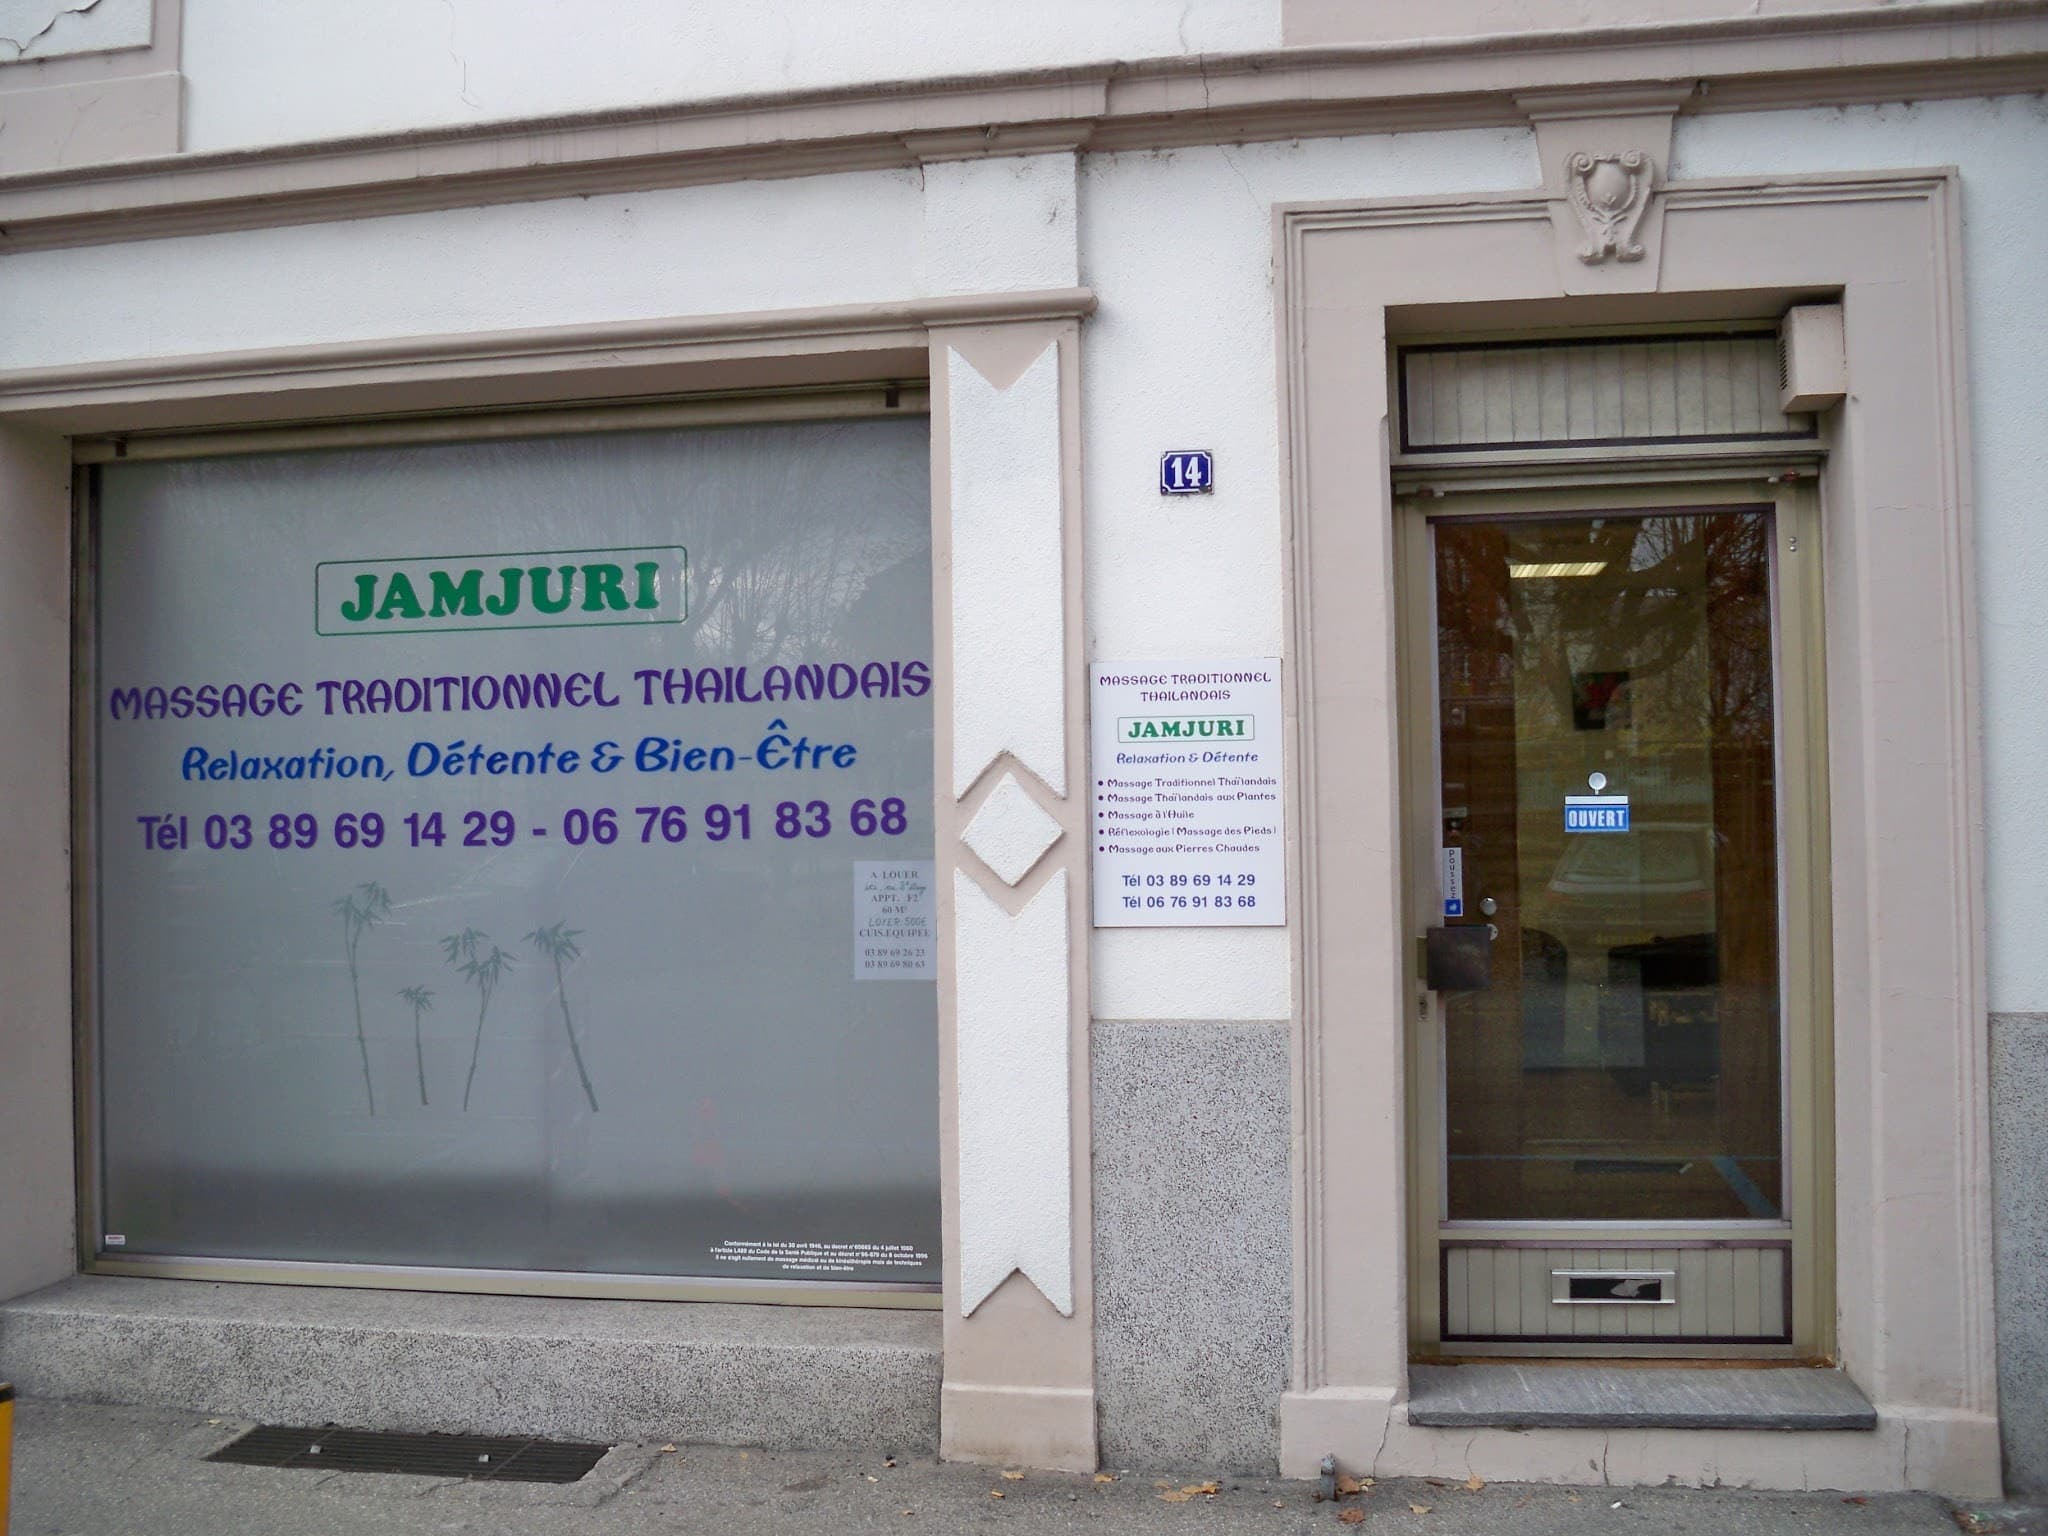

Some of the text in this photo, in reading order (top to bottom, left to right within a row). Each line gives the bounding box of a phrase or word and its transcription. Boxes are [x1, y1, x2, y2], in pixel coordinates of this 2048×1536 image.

[1171, 456, 1202, 487] 14
[340, 561, 660, 622] JAMJURI
[1099, 672, 1272, 686] MASSAGE TRADITIONNEL
[109, 660, 932, 720] MASSAGE TRADITIONNEL THAILANDAIS
[1140, 689, 1231, 702] THAILANDAIS
[1128, 719, 1245, 738] JAMJURI
[181, 718, 857, 782] Relaxation, Détente & Bien-Être
[1116, 750, 1258, 764] Relaxation & Détente
[1107, 776, 1277, 790] Massage Traditionnel Thaïlandais
[1107, 794, 1153, 804] Massage
[1154, 792, 1214, 802] Thaïlandais
[1237, 791, 1276, 801] Plantes
[1107, 810, 1153, 821] Massage
[1163, 809, 1195, 819] l'Huile
[1568, 809, 1626, 828] OUVERT
[137, 813, 188, 851] Tél
[204, 814, 254, 850] 03
[268, 812, 318, 849] 89
[334, 811, 385, 848] 69
[404, 811, 446, 847] 14
[462, 810, 515, 847] 29
[563, 807, 619, 846] 06
[635, 805, 688, 844] 76
[704, 803, 751, 841] 91
[775, 800, 832, 839] 83
[850, 797, 908, 836] 68
[1108, 827, 1170, 838] Réflexologie
[1224, 826, 1242, 836] des
[1108, 843, 1260, 855] Massage aux Pierres Chaudes
[882, 870, 918, 879] LOUER
[1122, 873, 1256, 887] Tél 03 89 69 14 29
[1122, 895, 1256, 908] Tél 06 76 91 83 68
